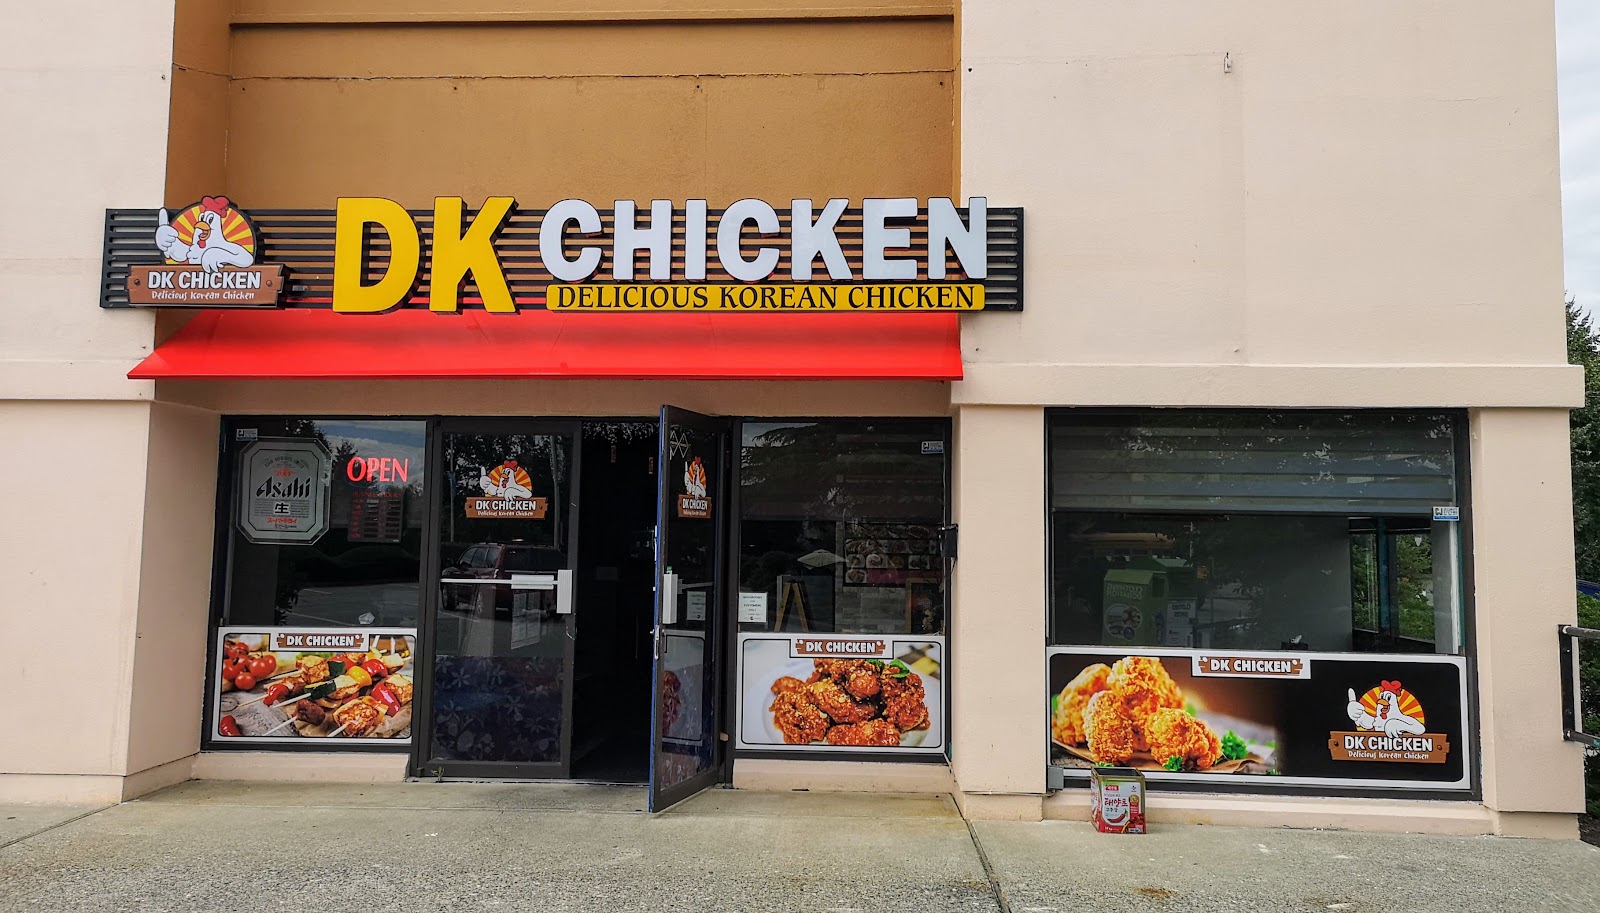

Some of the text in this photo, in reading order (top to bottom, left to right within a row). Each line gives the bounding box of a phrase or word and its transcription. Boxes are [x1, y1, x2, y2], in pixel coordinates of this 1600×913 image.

[538, 197, 988, 282] CHICKEN
[331, 196, 518, 313] DK
[148, 270, 261, 290] DK CHICKEN
[151, 290, 255, 301] Delicious Korean Chicken
[556, 285, 976, 310] DELICIOUS KOREAN CHICKEN
[346, 456, 409, 483] OPEN
[256, 476, 311, 498] Asahi
[274, 502, 290, 514] 生
[475, 500, 537, 511] DK CHICKEN
[682, 498, 708, 510] DK CHICKEN
[286, 636, 354, 646] DK CHICKEN
[805, 641, 876, 653] DK CHICKEN
[1210, 658, 1292, 673] DK CHICKEN
[1344, 736, 1433, 752] DK CHICKEN
[1348, 750, 1429, 760] Delicious Korean Chicken
[1104, 798, 1128, 808] 태양초
